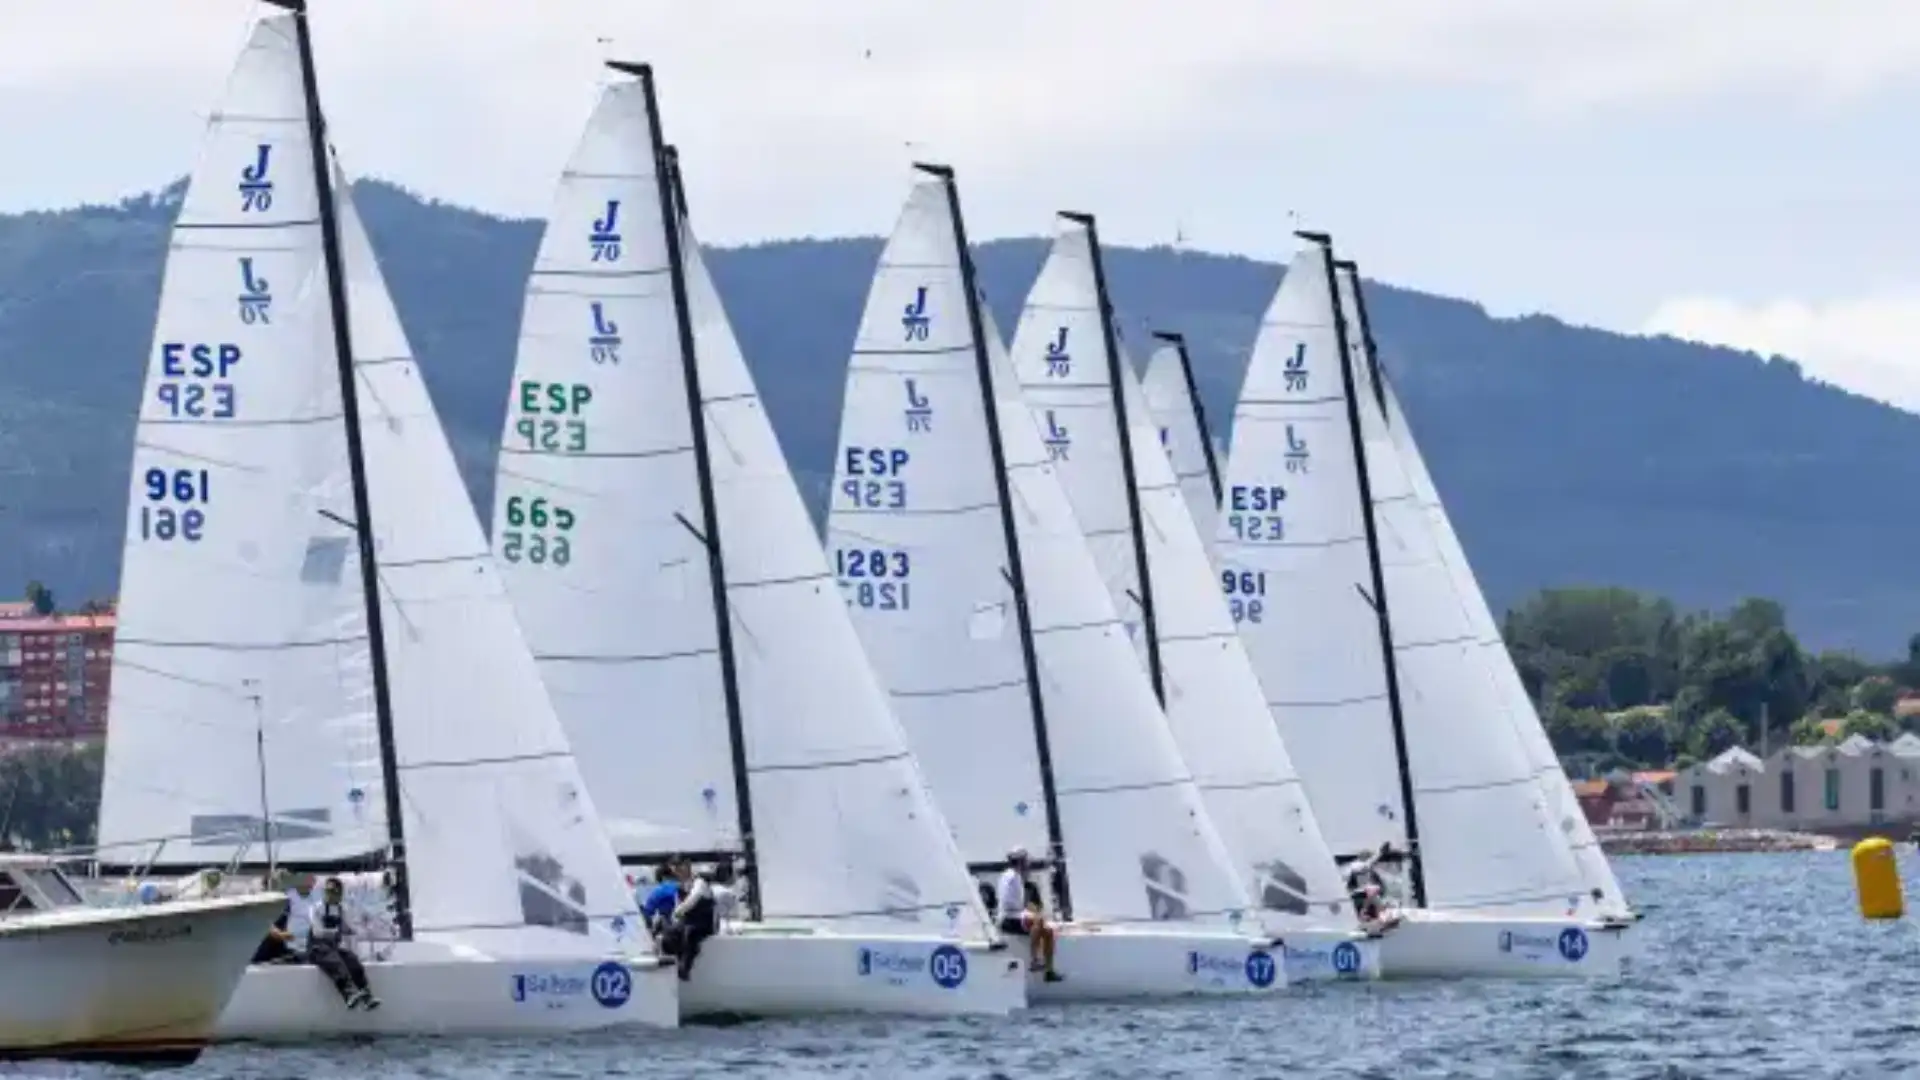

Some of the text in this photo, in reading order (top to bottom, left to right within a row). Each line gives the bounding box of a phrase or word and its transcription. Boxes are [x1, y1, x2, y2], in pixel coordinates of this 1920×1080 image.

[243, 144, 272, 181] J
[240, 191, 272, 212] 70
[593, 201, 621, 233] J
[590, 243, 621, 263] 70
[903, 287, 928, 316] J
[903, 324, 930, 342] 70
[1047, 327, 1069, 355] J
[163, 344, 241, 377] ESP
[1285, 343, 1308, 369] J
[521, 381, 592, 415] ESP
[846, 447, 909, 476] ESP
[145, 469, 209, 503] 961
[1231, 486, 1287, 513] ESP
[836, 549, 910, 578] 1283
[1222, 569, 1266, 597] 961
[1561, 935, 1584, 955] 14
[935, 954, 962, 979] 05
[1253, 955, 1272, 982] 17
[1336, 949, 1356, 970] 01
[597, 971, 628, 1000] 02
